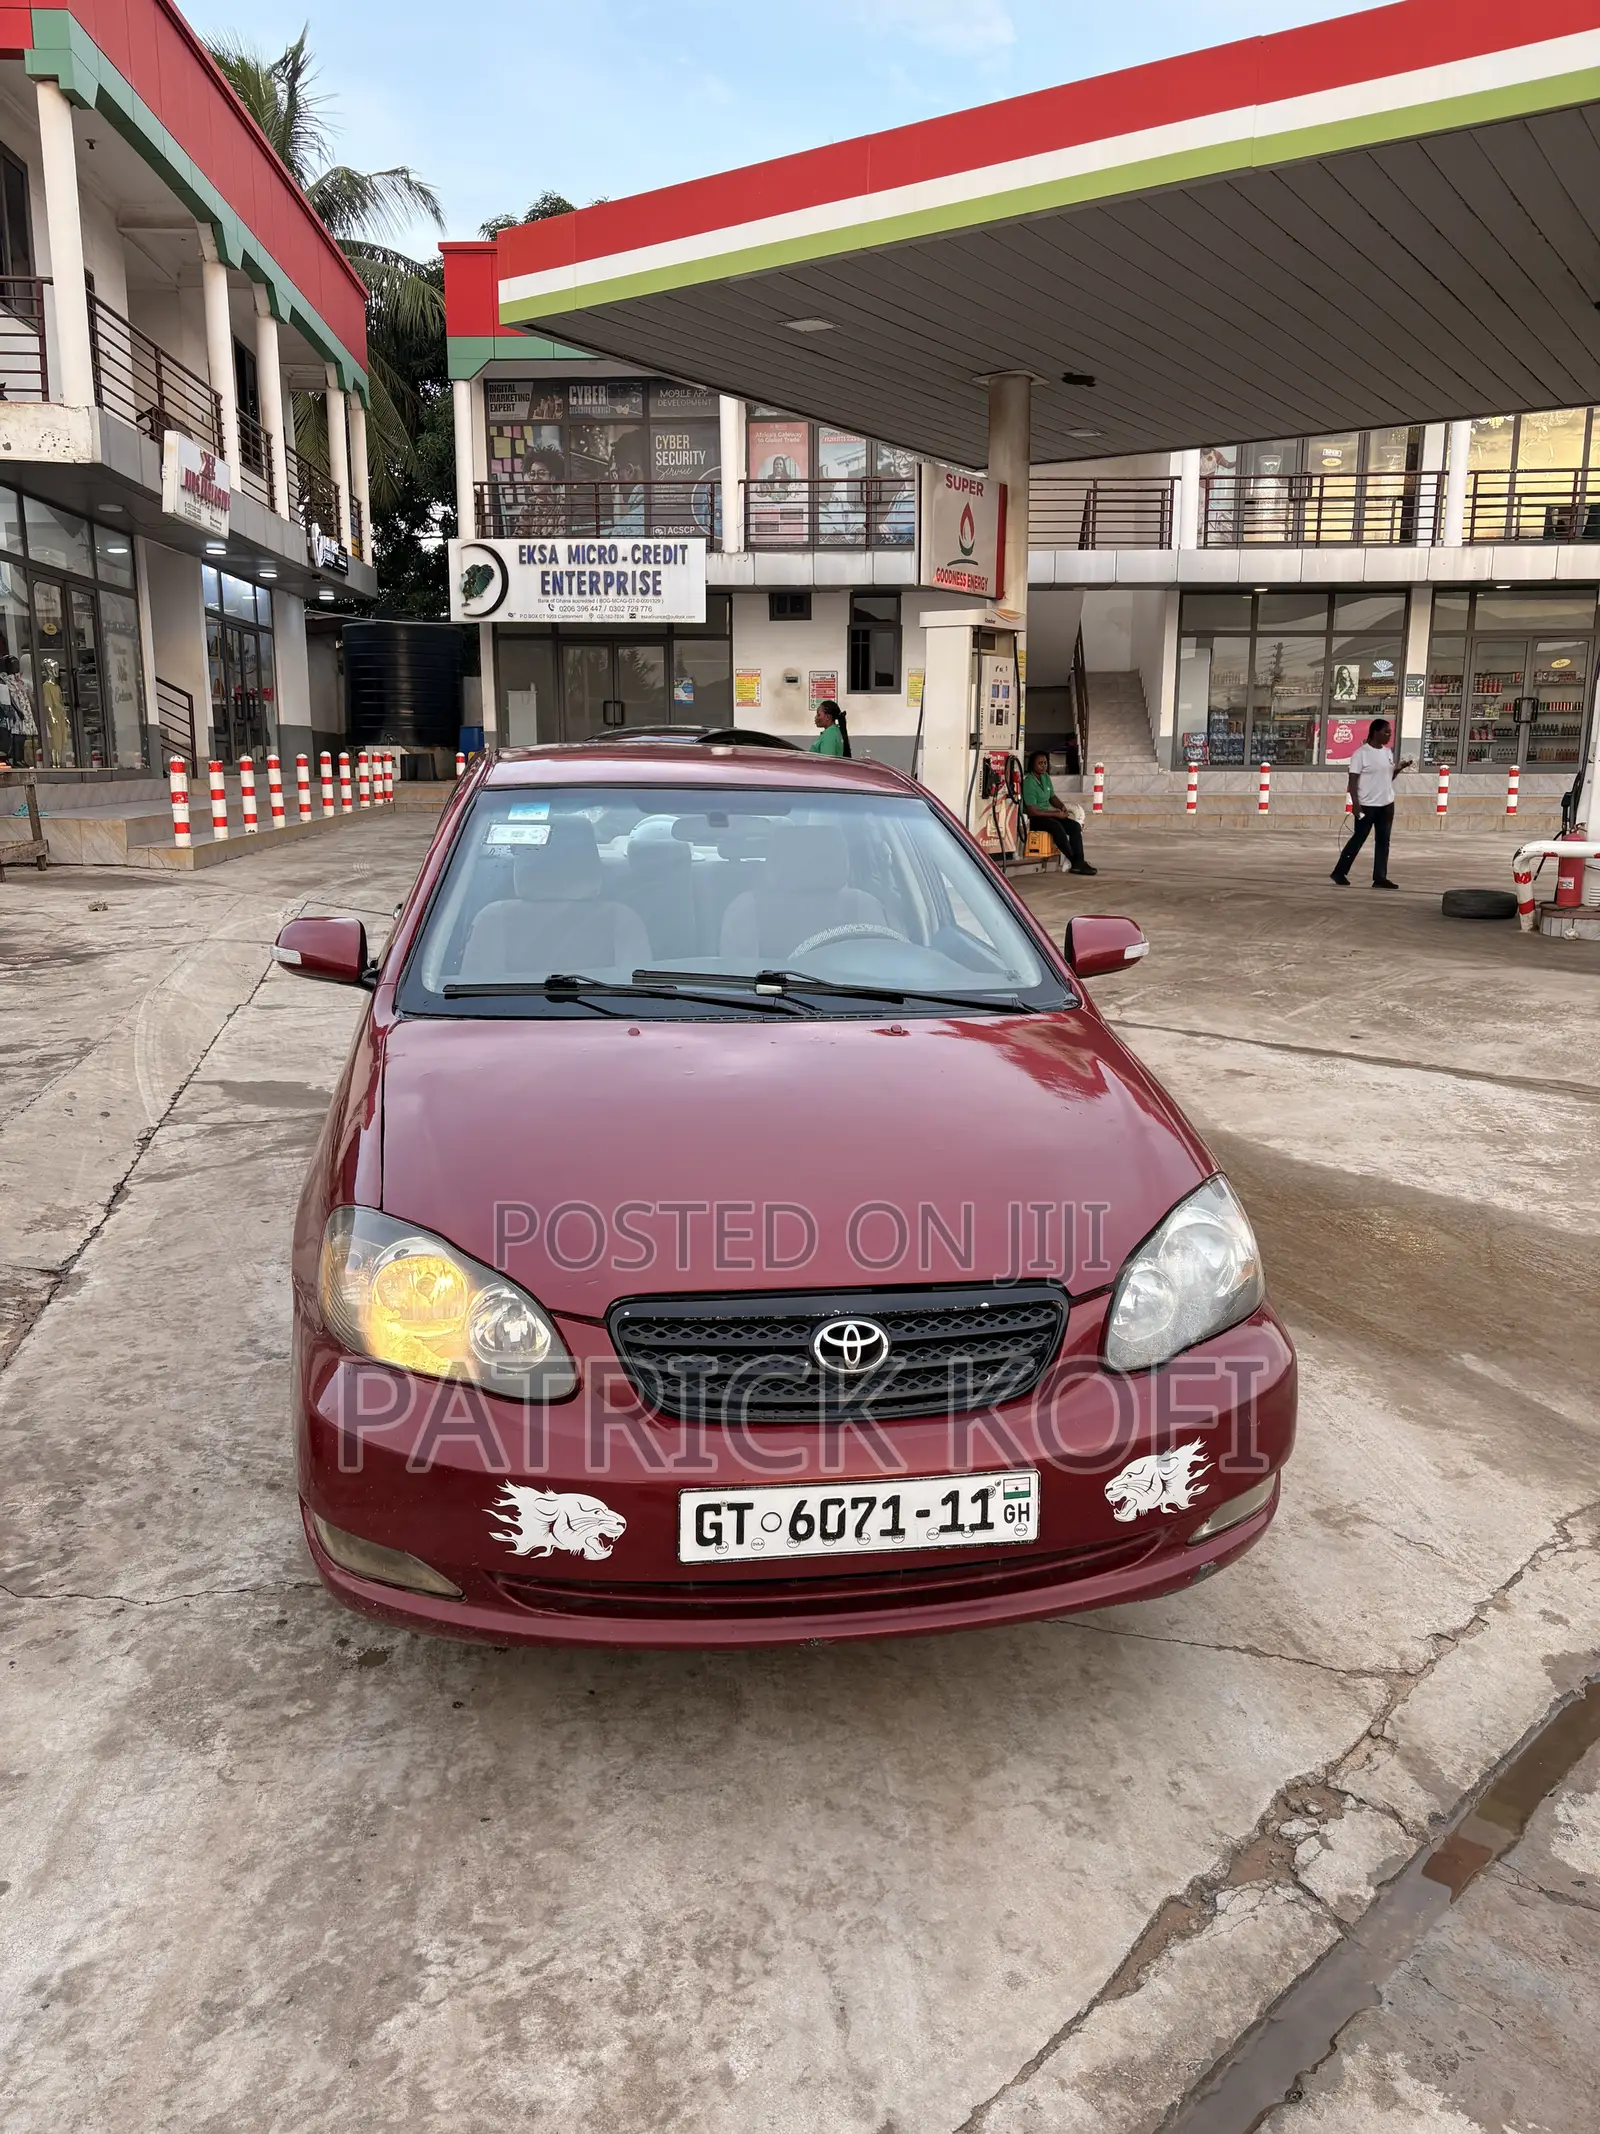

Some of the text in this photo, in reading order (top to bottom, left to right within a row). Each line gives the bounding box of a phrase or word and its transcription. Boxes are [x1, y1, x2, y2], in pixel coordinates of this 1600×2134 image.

[489, 384, 516, 393] DIGITAL
[569, 386, 606, 405] CYBER
[659, 389, 709, 398] MOBILE APP
[489, 393, 530, 403] MARKETING
[657, 399, 713, 407] DEVELOPMENT
[490, 403, 516, 412] EXPERT
[655, 434, 690, 450] CYBER
[655, 450, 706, 466] SECURITY
[655, 465, 692, 480] Service
[945, 473, 984, 497] SUPER
[667, 526, 696, 535] ACSCP
[518, 544, 559, 565] EKSA
[540, 570, 662, 596] ENTERPRISE
[936, 567, 989, 591] GOODNESS ENERGY
[1004, 1502, 1030, 1524] GH
[695, 1502, 754, 1546] GT
